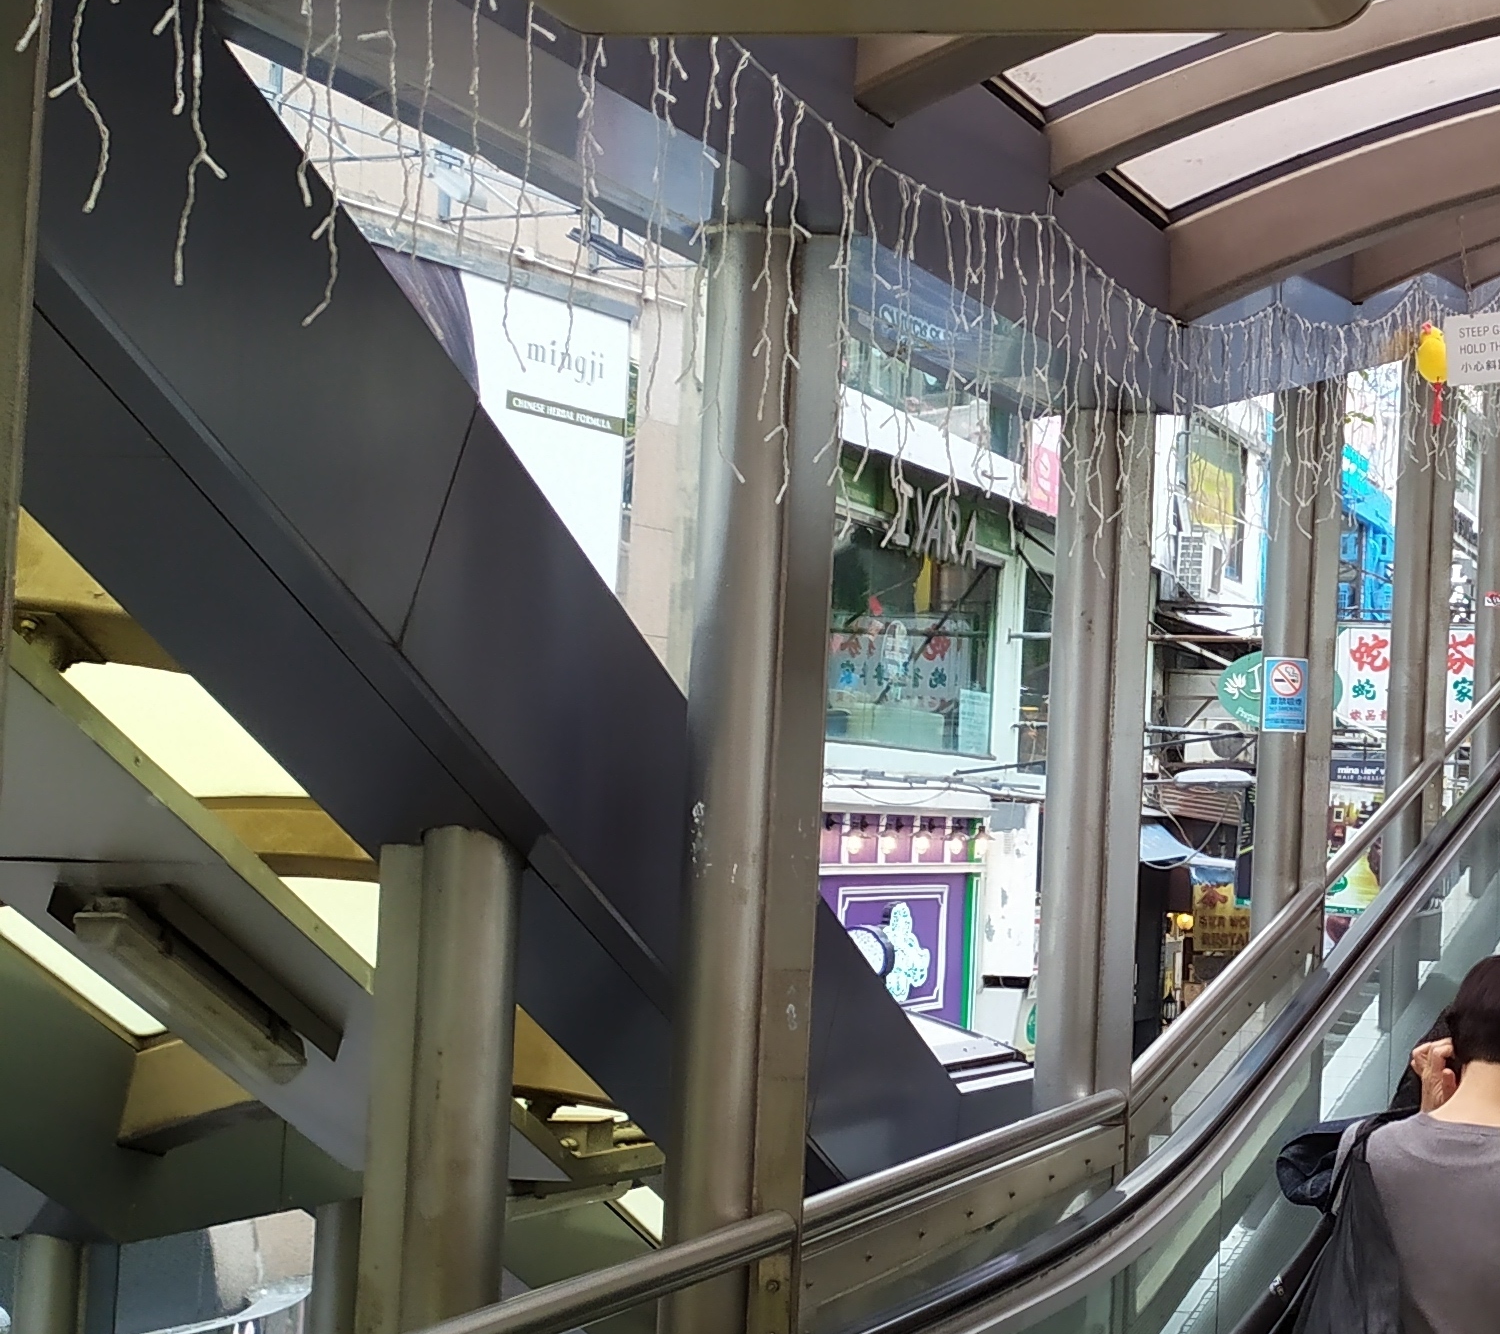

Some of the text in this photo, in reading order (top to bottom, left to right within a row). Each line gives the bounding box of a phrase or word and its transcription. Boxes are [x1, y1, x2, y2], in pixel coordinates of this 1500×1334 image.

[1459, 325, 1489, 339] STEEP
[1459, 342, 1486, 355] HOLD
[526, 339, 605, 387] mingji
